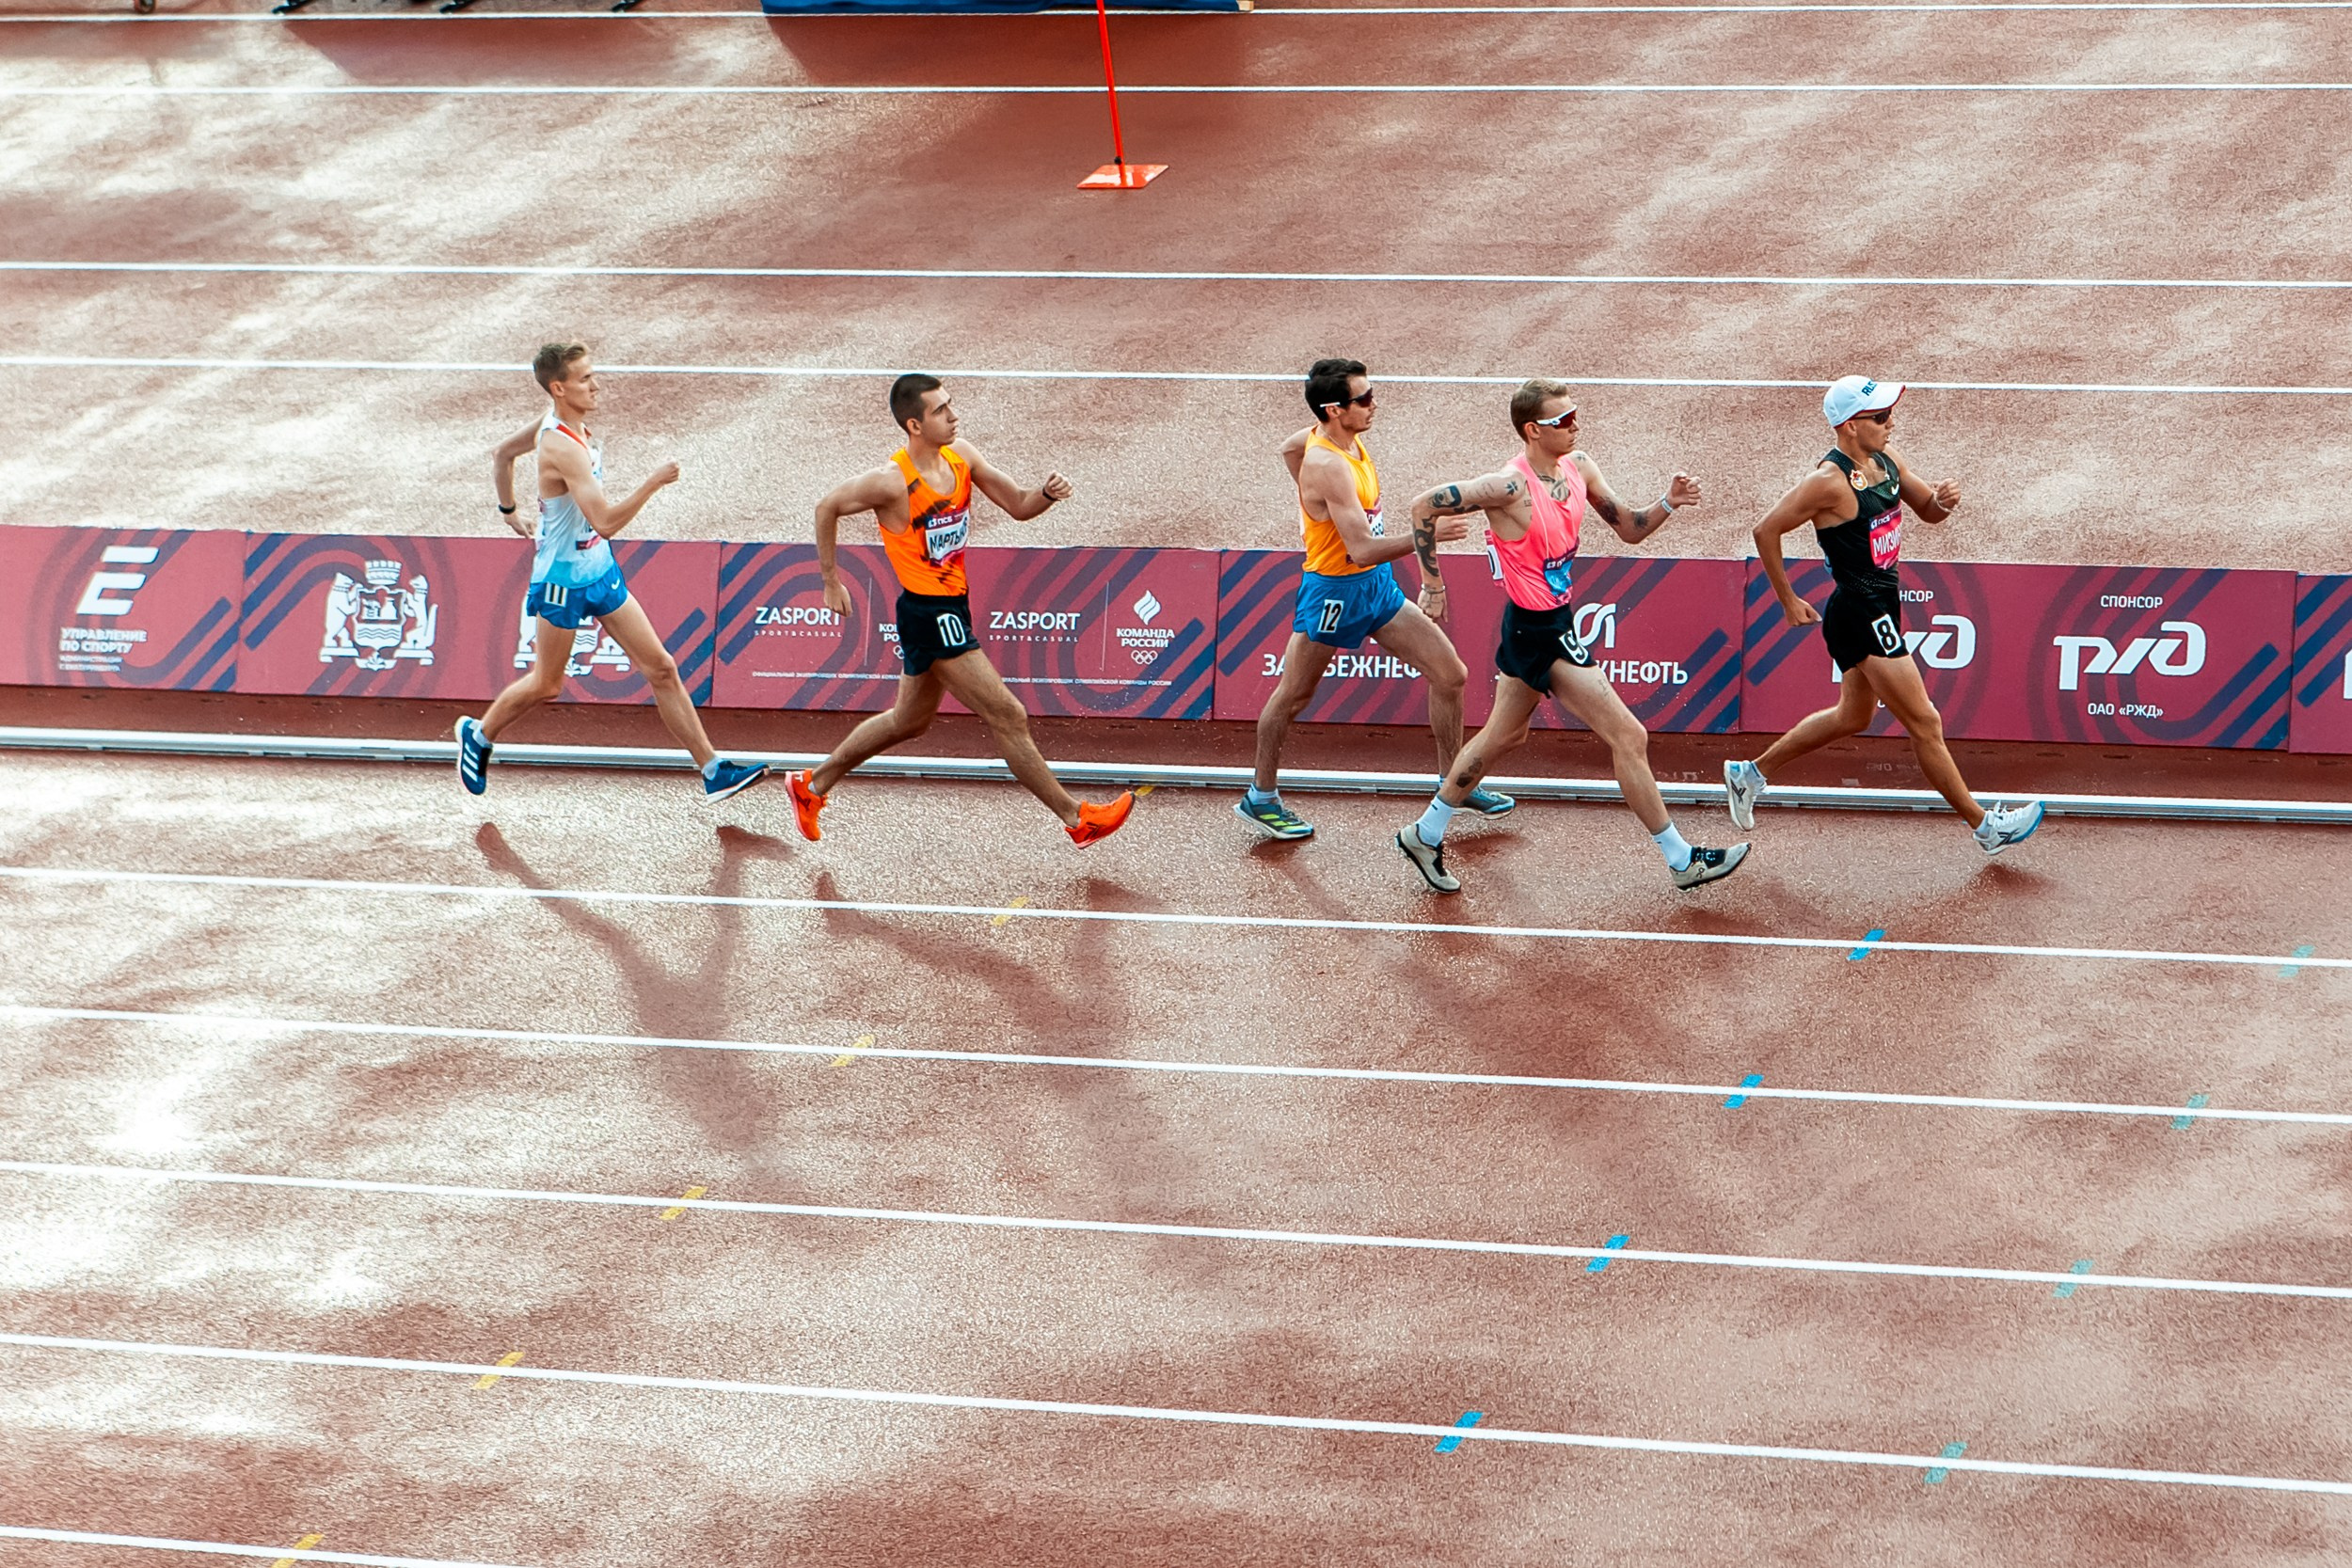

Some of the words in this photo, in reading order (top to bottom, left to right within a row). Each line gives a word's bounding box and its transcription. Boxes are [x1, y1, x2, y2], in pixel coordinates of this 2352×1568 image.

[549, 582, 567, 604] 11
[1899, 590, 1934, 602] НСОР
[2100, 595, 2163, 609] СПОНСОР
[990, 611, 1080, 630] ZASPORT
[1321, 603, 1342, 631] 12
[60, 627, 148, 642] УПРАВЛЕНИЕ
[940, 615, 963, 647] 10
[1116, 628, 1175, 639] КОМАНДА
[1877, 619, 1898, 651] 8
[60, 640, 81, 652] ПО
[81, 641, 133, 653] СПОРТУ
[1121, 639, 1168, 648] РОССИИ
[2087, 703, 2115, 715] ОАО
[2119, 705, 2164, 718] «РЖД»
